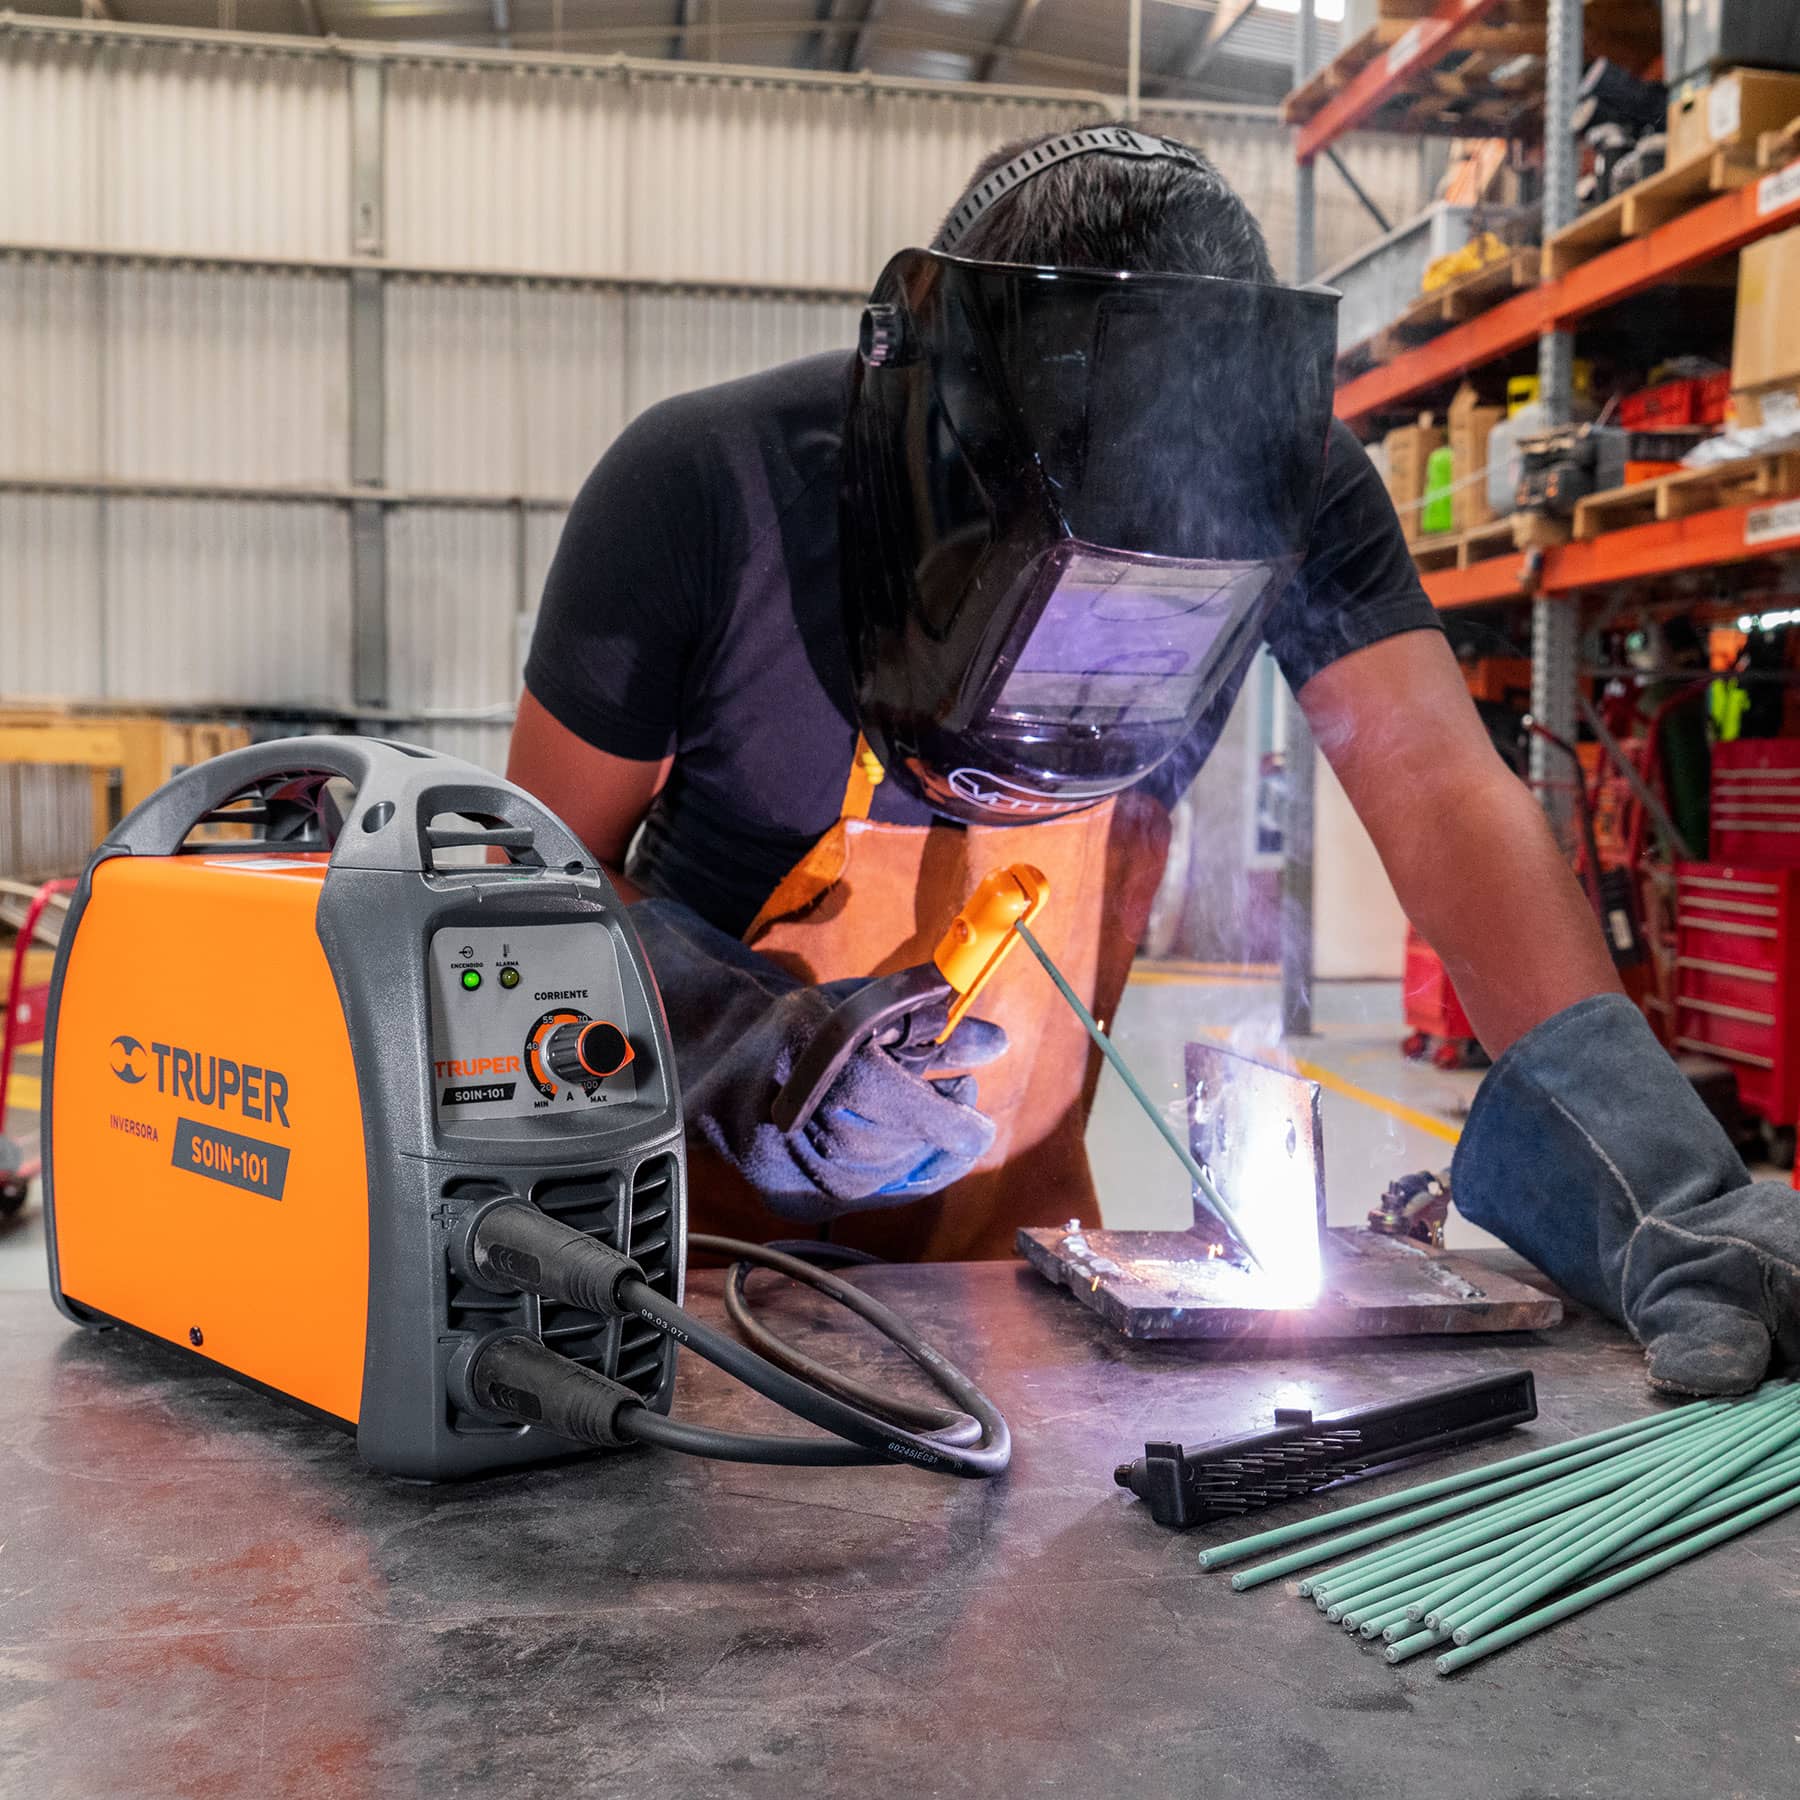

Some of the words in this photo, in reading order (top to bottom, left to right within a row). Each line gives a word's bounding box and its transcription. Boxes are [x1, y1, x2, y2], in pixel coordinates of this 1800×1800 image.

[534, 989, 589, 1001] CORRIENTE
[542, 1015, 554, 1024] 55
[526, 1042, 539, 1050] 40
[433, 1055, 521, 1079] TRUPER
[151, 1041, 290, 1129] TRUPER
[540, 1084, 552, 1092] 20
[584, 1081, 598, 1089] 100
[455, 1088, 505, 1102] SOIN-101
[566, 1091, 574, 1101] A
[590, 1095, 607, 1103] MAX
[534, 1100, 549, 1109] MIN
[110, 1113, 159, 1143] INVERSORA
[191, 1135, 268, 1185] SOIN-101
